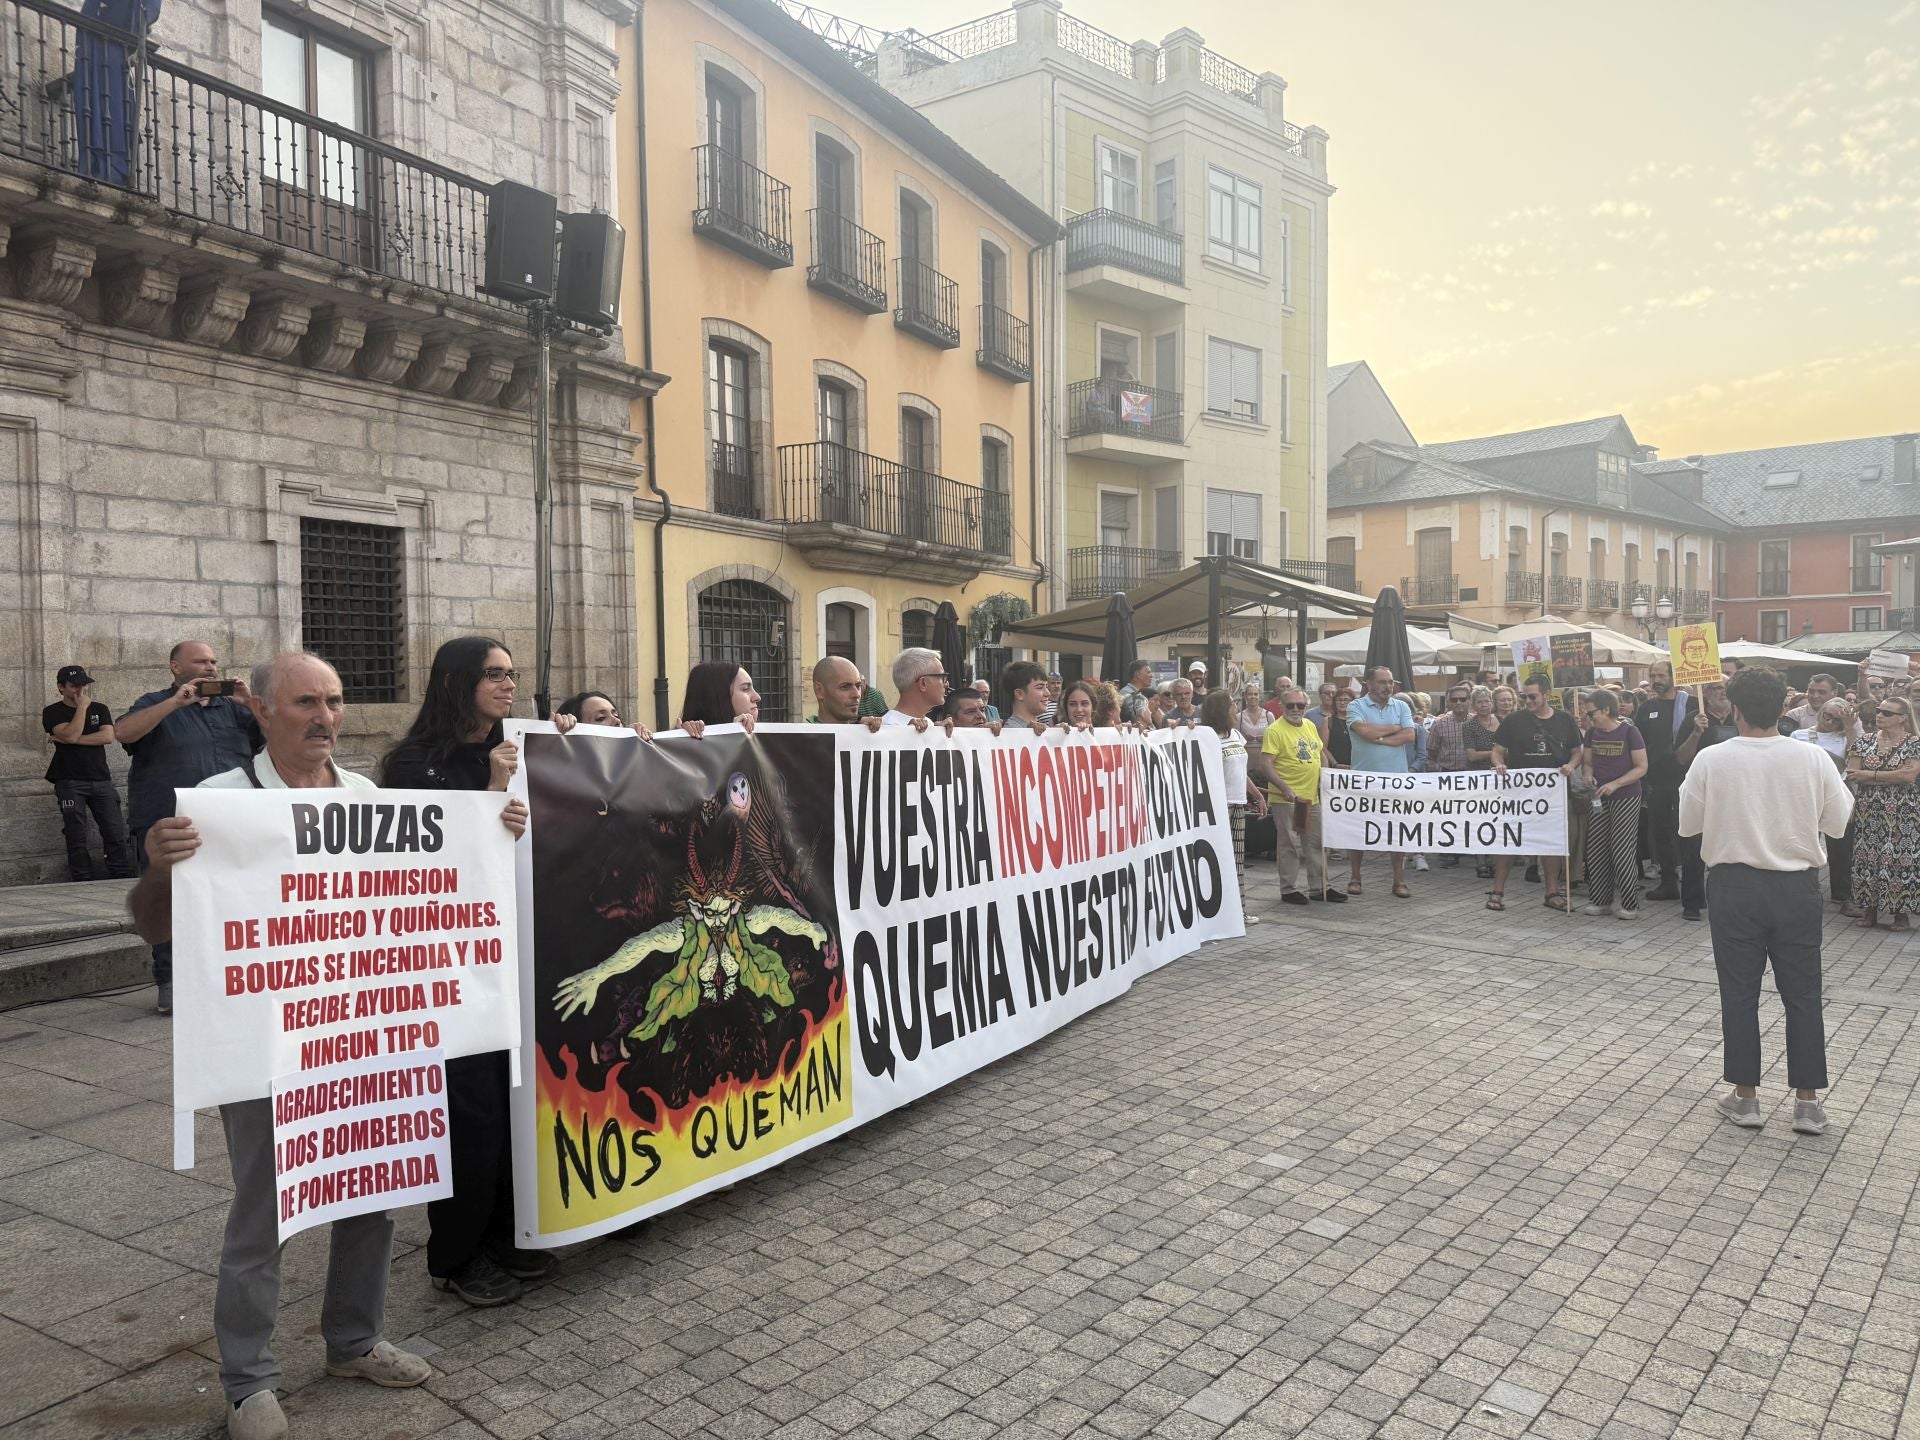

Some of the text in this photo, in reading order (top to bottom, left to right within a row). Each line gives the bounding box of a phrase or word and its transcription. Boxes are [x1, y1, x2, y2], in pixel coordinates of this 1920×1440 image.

[1329, 773, 1416, 790] INEPTOS
[1438, 772, 1559, 791] MENTIROSOS
[1329, 796, 1549, 816] GOBIERNO AUTONÓMICO
[291, 802, 444, 855] BOUZAS
[839, 747, 994, 910] VUESTRA
[1364, 816, 1523, 848] DIMISIÓN
[281, 867, 458, 903] PIDE LA DIMISION
[224, 900, 501, 951] DE MAÑUECO Y QUIÑONES.
[225, 938, 502, 997] BOUZAS SE INCENDIA Y NO
[853, 901, 1016, 1083] QUEMA
[1016, 861, 1138, 1009] NUESTRO
[283, 979, 462, 1032] RECIBE AYUDA DE
[300, 1020, 440, 1071] NINGUN TIPO
[276, 1064, 443, 1127] AGRADECIMIENTO
[554, 1020, 842, 1209] NOS QUEMAN
[277, 1107, 446, 1177] A DOS BOMBEROS
[281, 1153, 440, 1224] DE PONFERRADA
